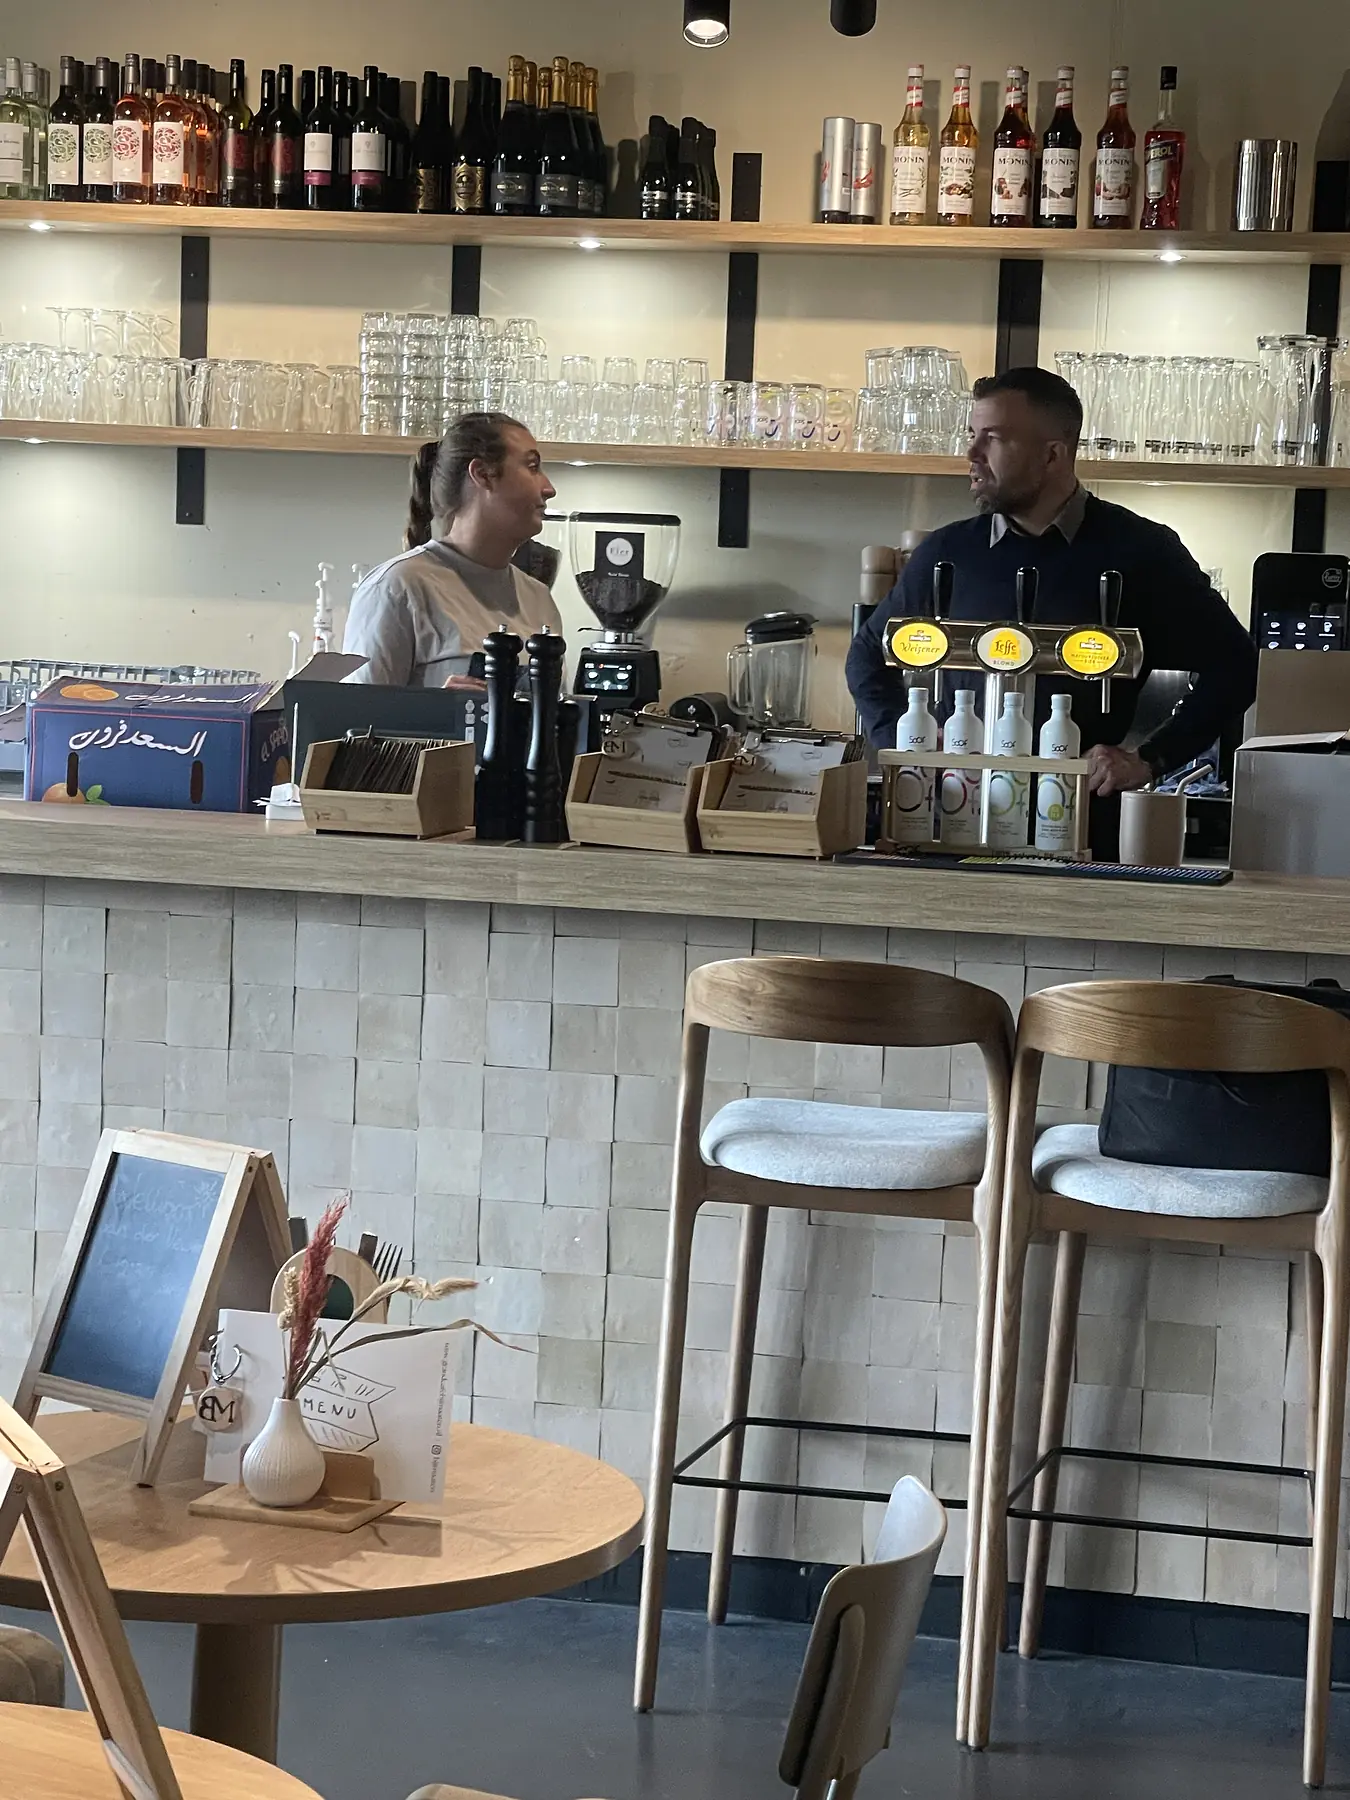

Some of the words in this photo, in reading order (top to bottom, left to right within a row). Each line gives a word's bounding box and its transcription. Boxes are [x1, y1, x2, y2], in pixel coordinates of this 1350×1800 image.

[943, 156, 975, 164] MONIN
[998, 157, 1031, 165] MONIN
[1043, 157, 1077, 166] MONIN
[1098, 157, 1131, 166] MONIN
[899, 641, 941, 655] Weizener
[994, 639, 1017, 656] Leffe
[993, 659, 1015, 667] BLOND
[303, 1397, 357, 1420] MENU
